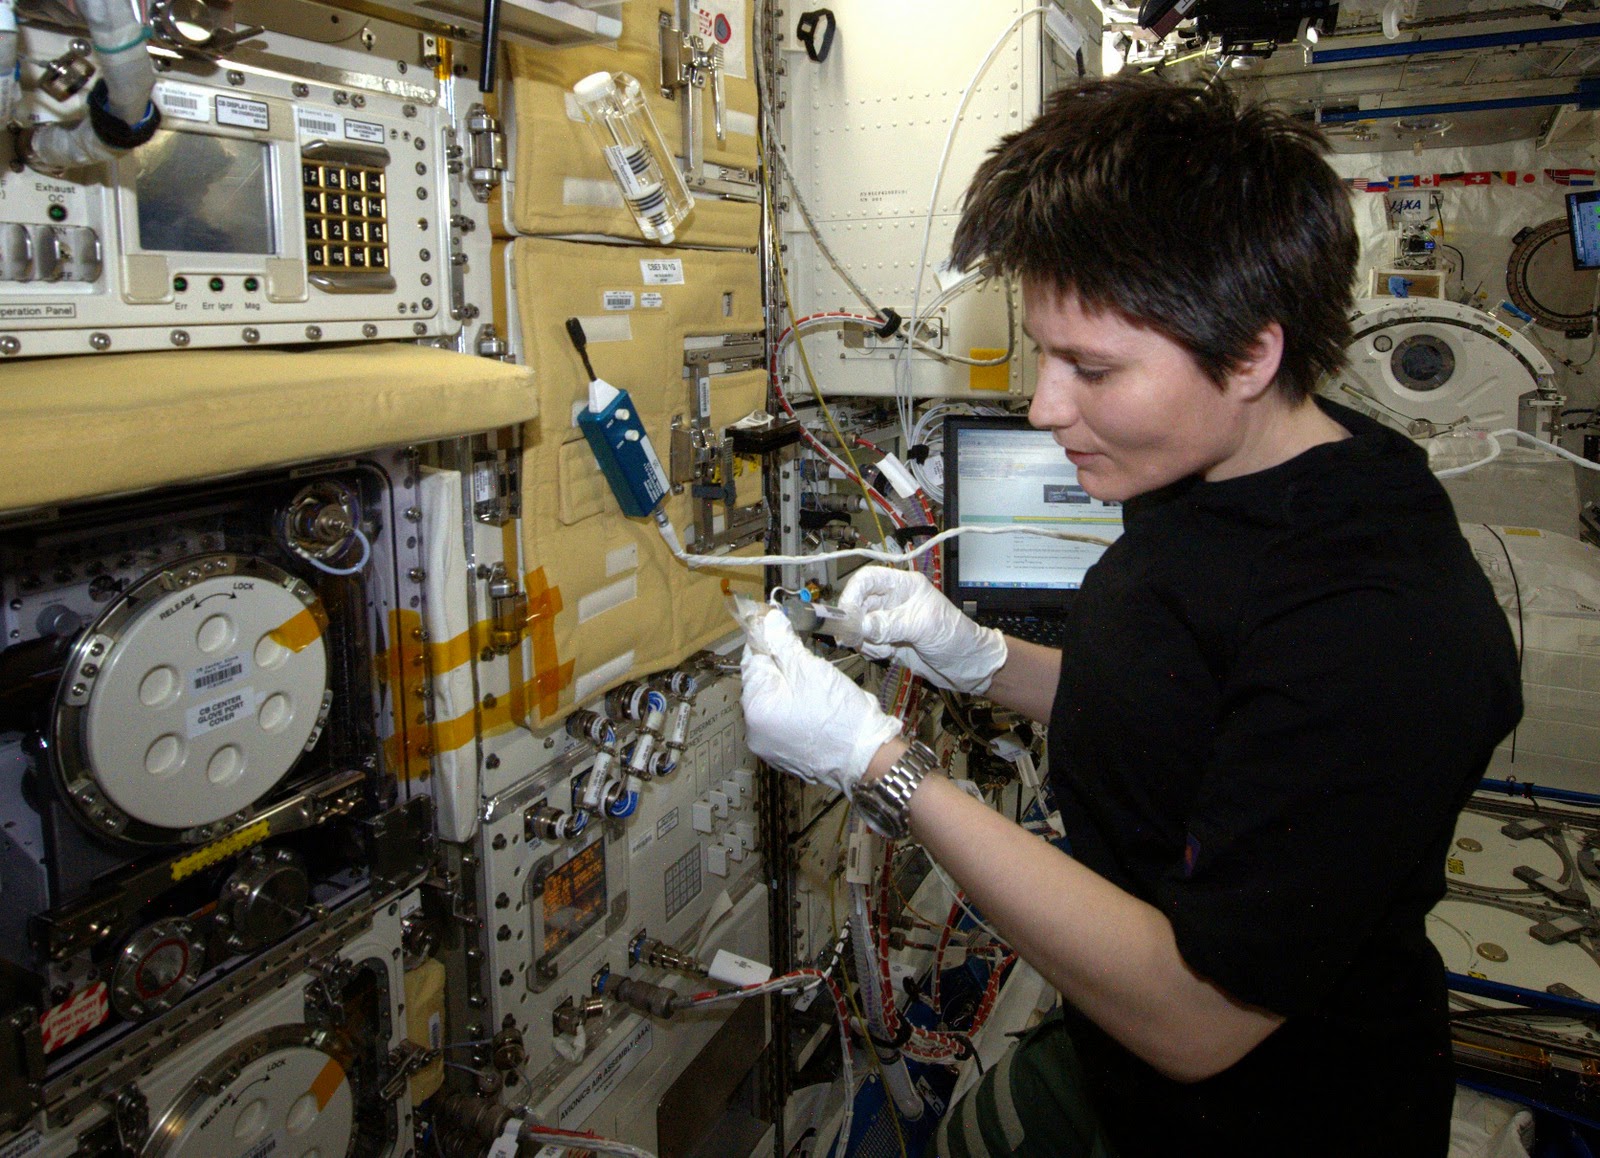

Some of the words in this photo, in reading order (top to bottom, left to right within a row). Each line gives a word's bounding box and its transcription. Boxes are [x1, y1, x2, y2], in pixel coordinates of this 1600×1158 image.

[226, 101, 248, 109] DISPLAY
[310, 170, 318, 180] 7
[330, 173, 338, 183] 8
[351, 175, 359, 185] 9
[35, 183, 75, 194] Exhaust
[310, 197, 318, 207] 4
[332, 199, 340, 209] 5
[353, 201, 360, 211] 6
[312, 223, 319, 234] 1
[333, 225, 341, 235] 2
[354, 226, 362, 236] 3
[45, 306, 73, 316] Panel
[175, 302, 187, 310] Err
[202, 302, 214, 310] Err
[233, 582, 255, 590] LOCK
[159, 593, 196, 620] RELEASE
[199, 706, 211, 716] CB
[212, 694, 242, 711] CENTER
[197, 709, 223, 724] GLOVE
[224, 701, 244, 713] PORT
[209, 712, 235, 727] COVER
[267, 1059, 287, 1071] LOCK
[560, 1085, 591, 1121] AVIONICS
[592, 1073, 602, 1090] AIR
[603, 1041, 634, 1077] ASSEMBLY
